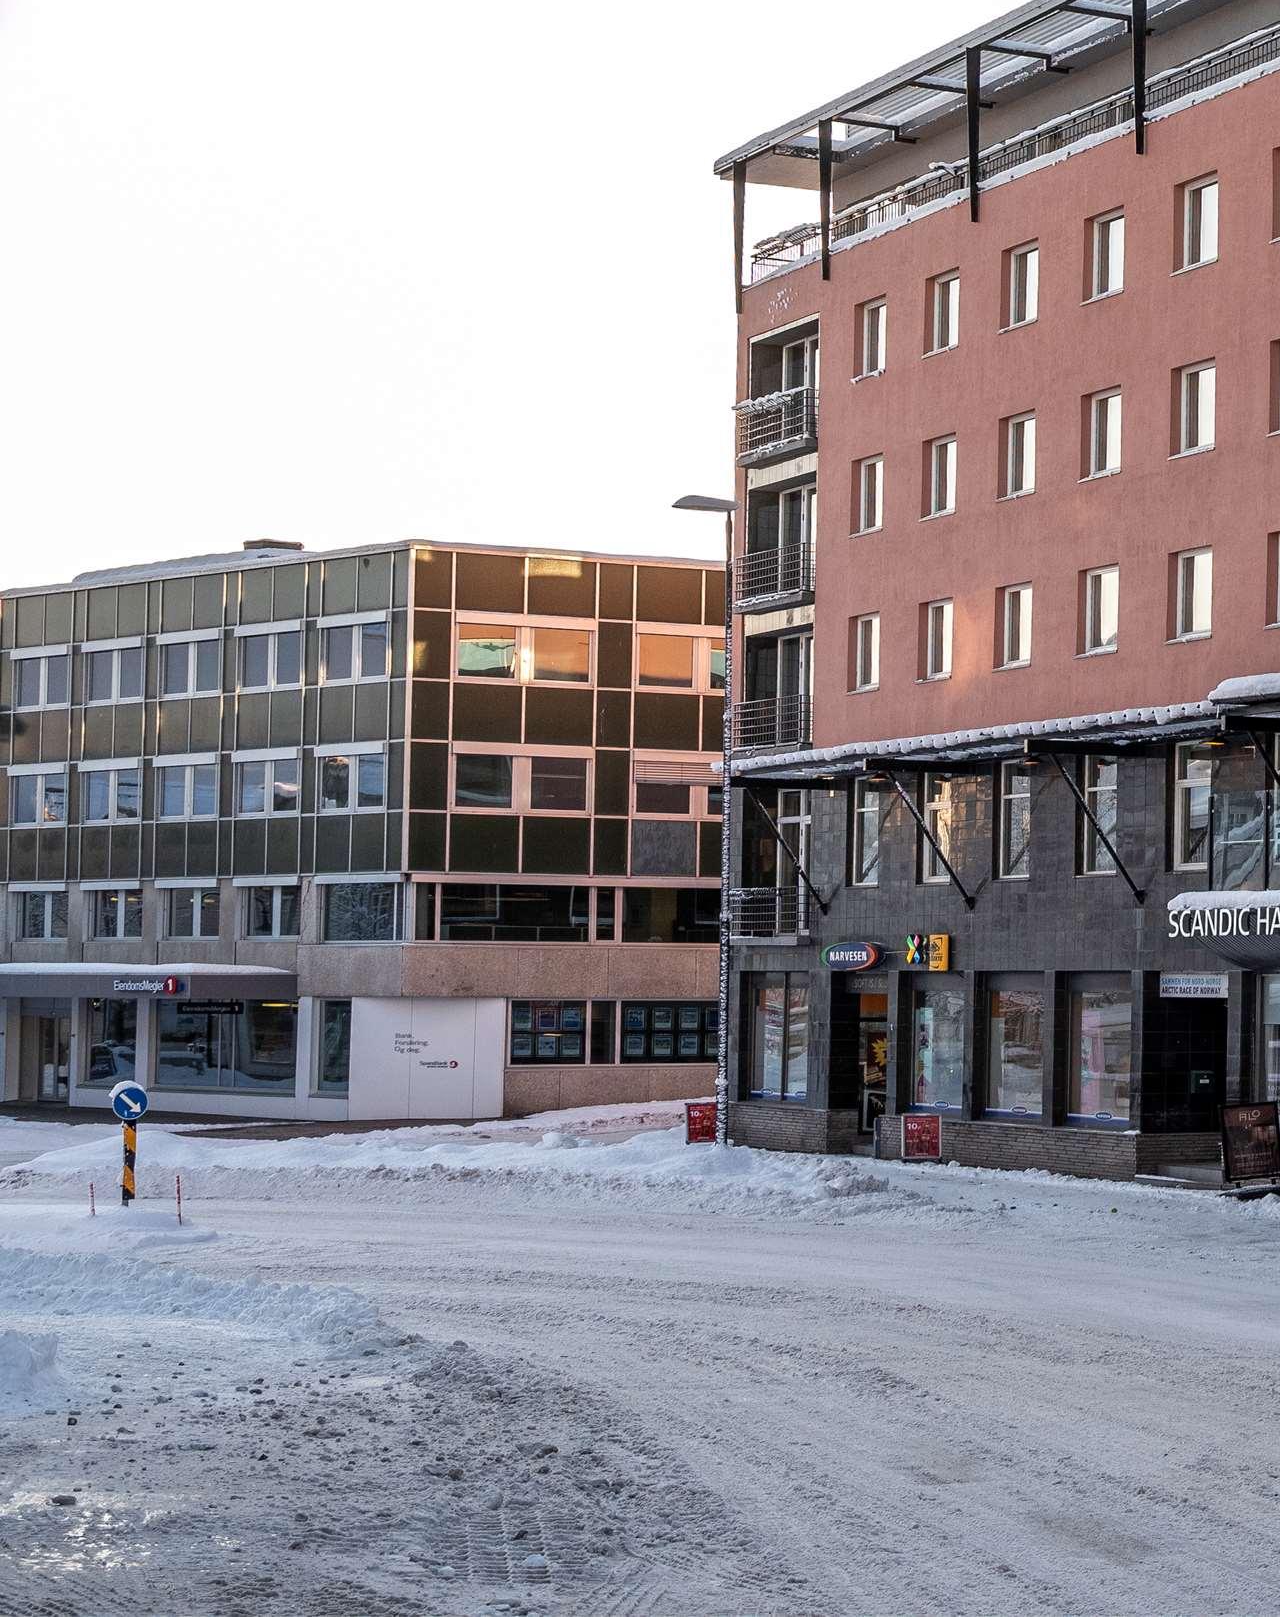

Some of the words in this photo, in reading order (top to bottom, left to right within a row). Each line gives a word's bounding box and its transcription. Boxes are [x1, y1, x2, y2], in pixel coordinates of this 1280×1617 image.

[1168, 908, 1250, 938] SCANDIC
[829, 950, 868, 961] NARVESEN
[167, 978, 174, 991] 1
[1161, 985, 1179, 994] ARCTIC
[1179, 985, 1192, 994] RACE
[1193, 986, 1199, 994] OF
[1199, 986, 1222, 994] NORWAY
